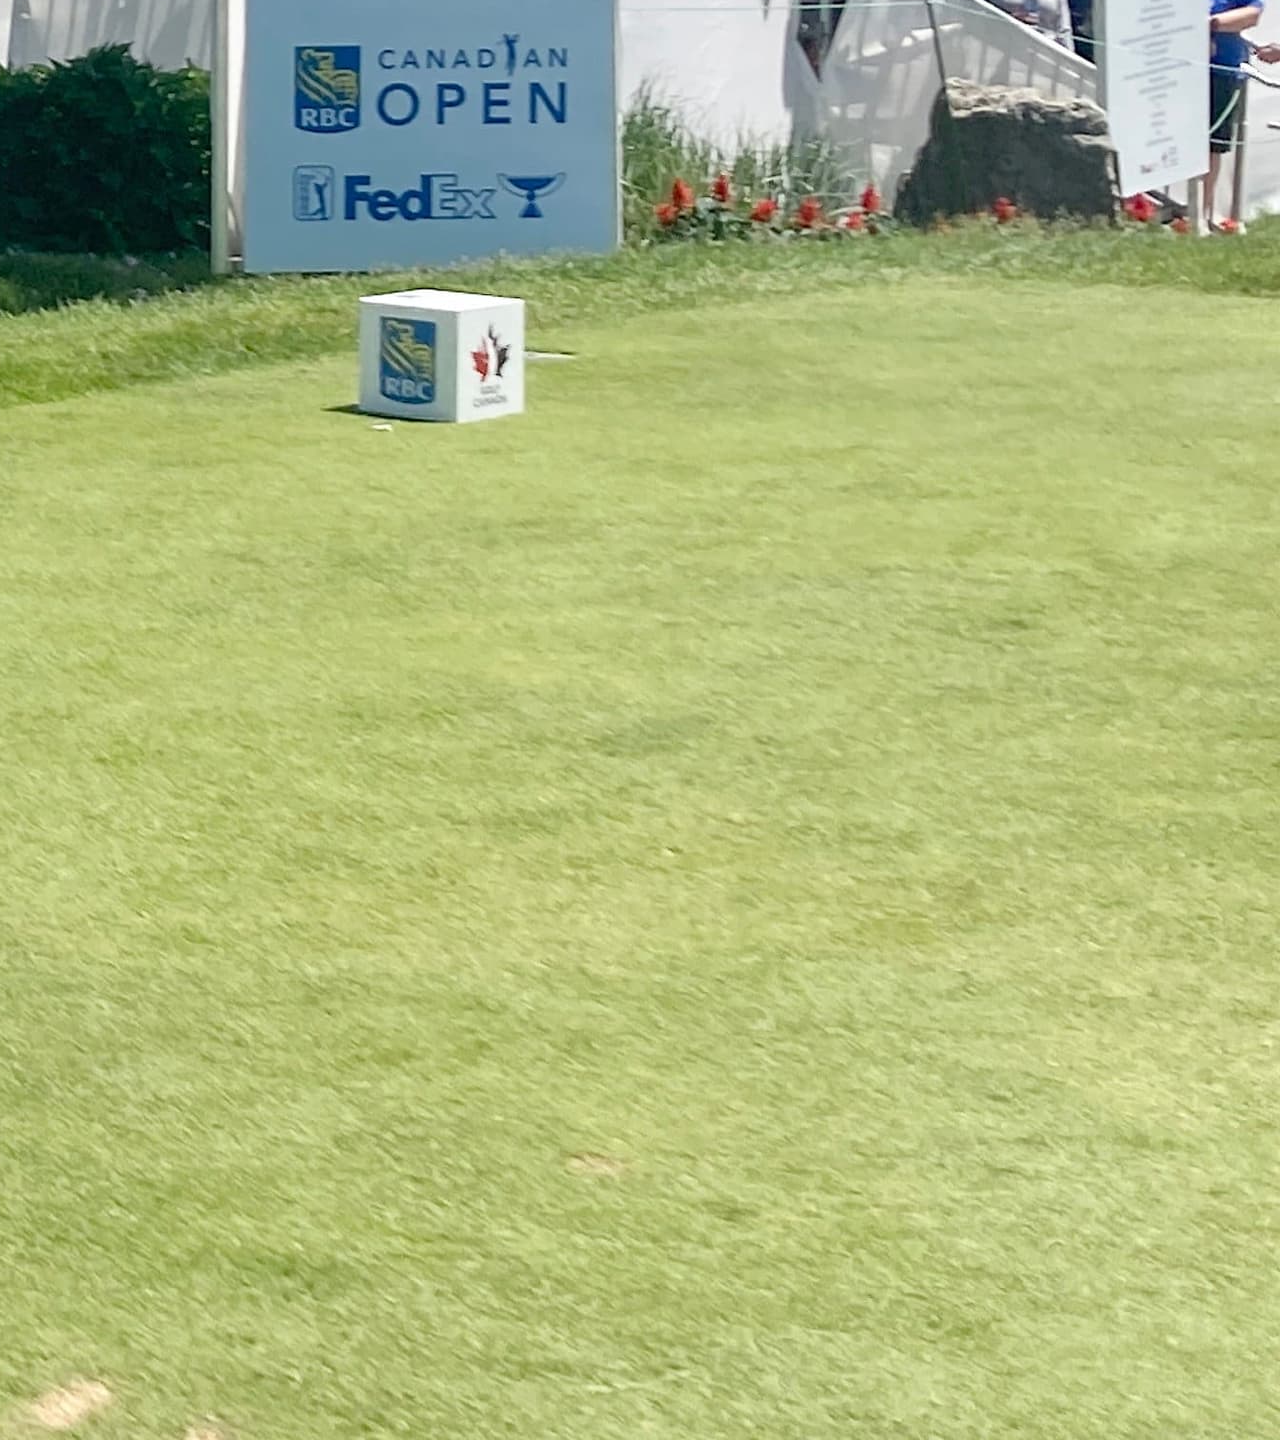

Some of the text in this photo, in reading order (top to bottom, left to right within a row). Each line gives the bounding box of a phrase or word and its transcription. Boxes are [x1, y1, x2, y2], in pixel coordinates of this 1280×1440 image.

[300, 107, 357, 128] RBC
[377, 82, 568, 126] OPEN
[343, 173, 497, 221] FedEx
[384, 377, 433, 399] RBC
